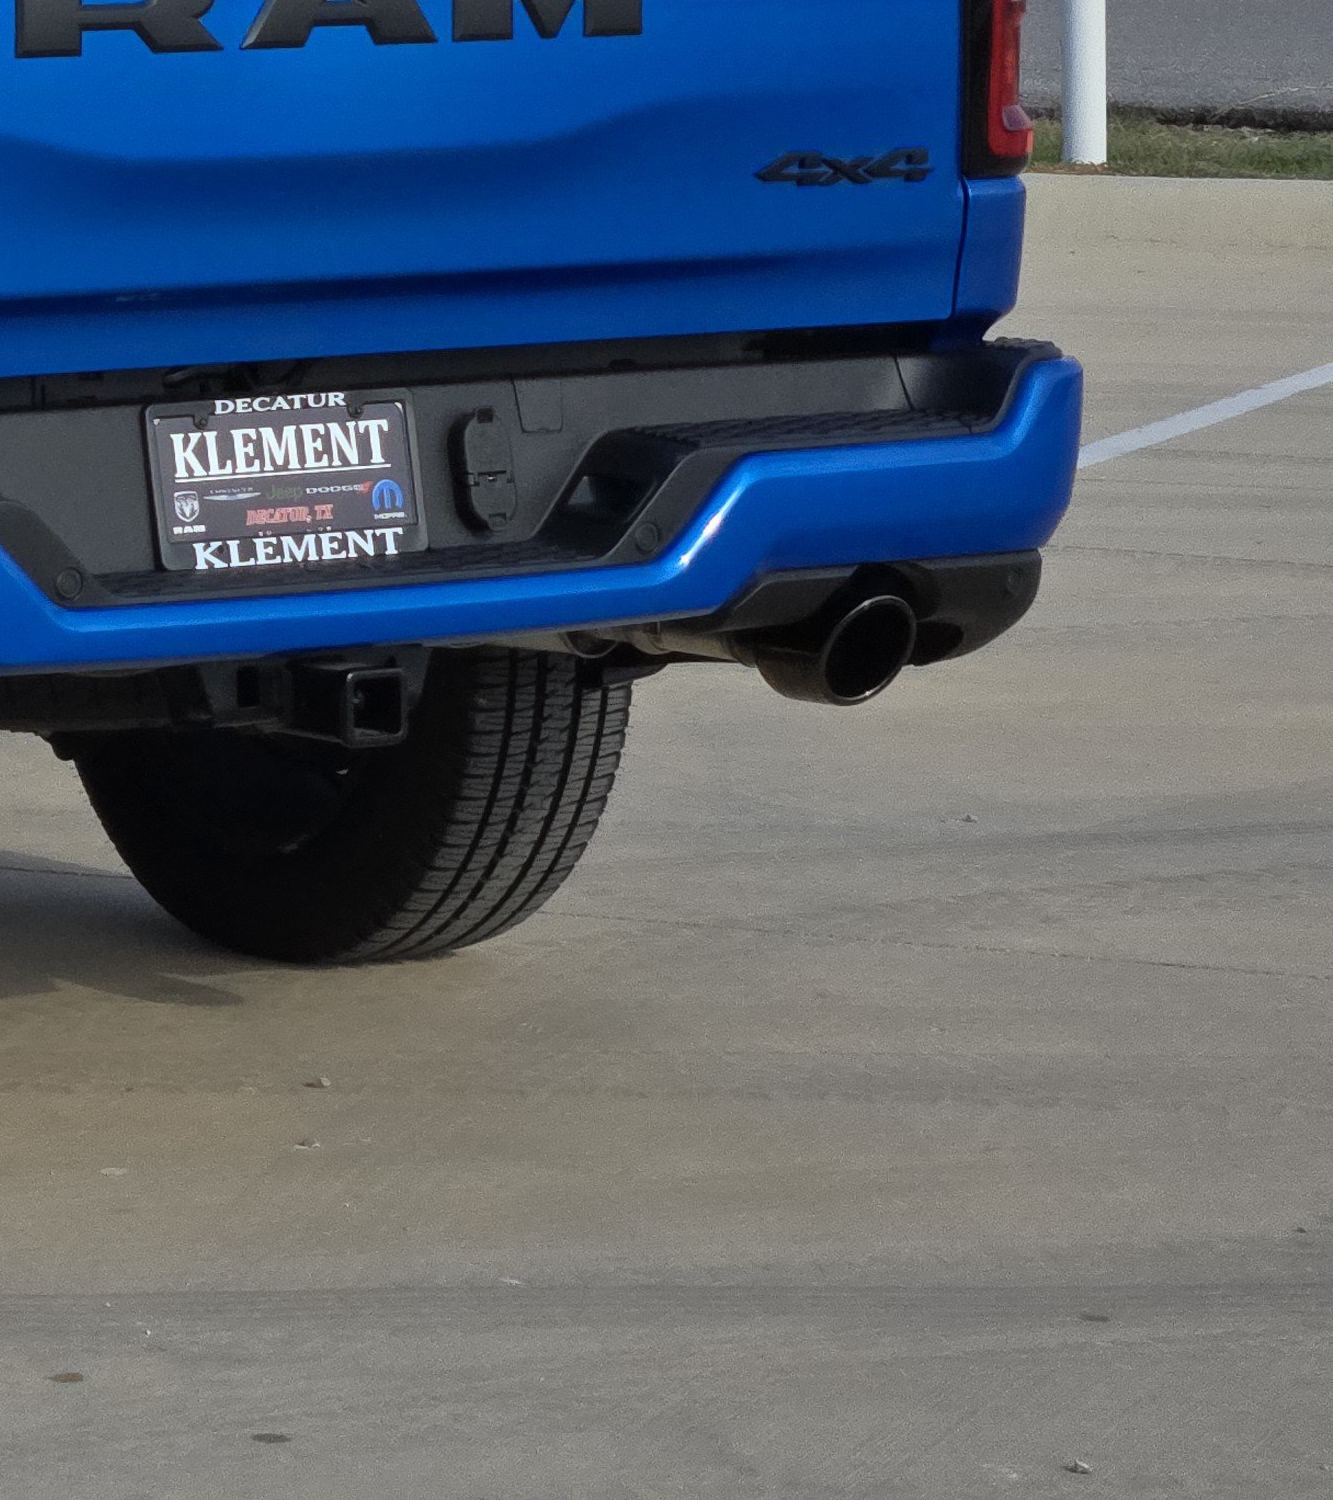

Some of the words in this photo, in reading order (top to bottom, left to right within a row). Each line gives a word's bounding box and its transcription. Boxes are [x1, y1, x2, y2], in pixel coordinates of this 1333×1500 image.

[214, 392, 346, 415] DECATUR
[170, 419, 388, 478] KLEMENT
[314, 504, 334, 520] TX
[173, 524, 206, 535] RAM
[192, 527, 403, 570] KLEMENT
